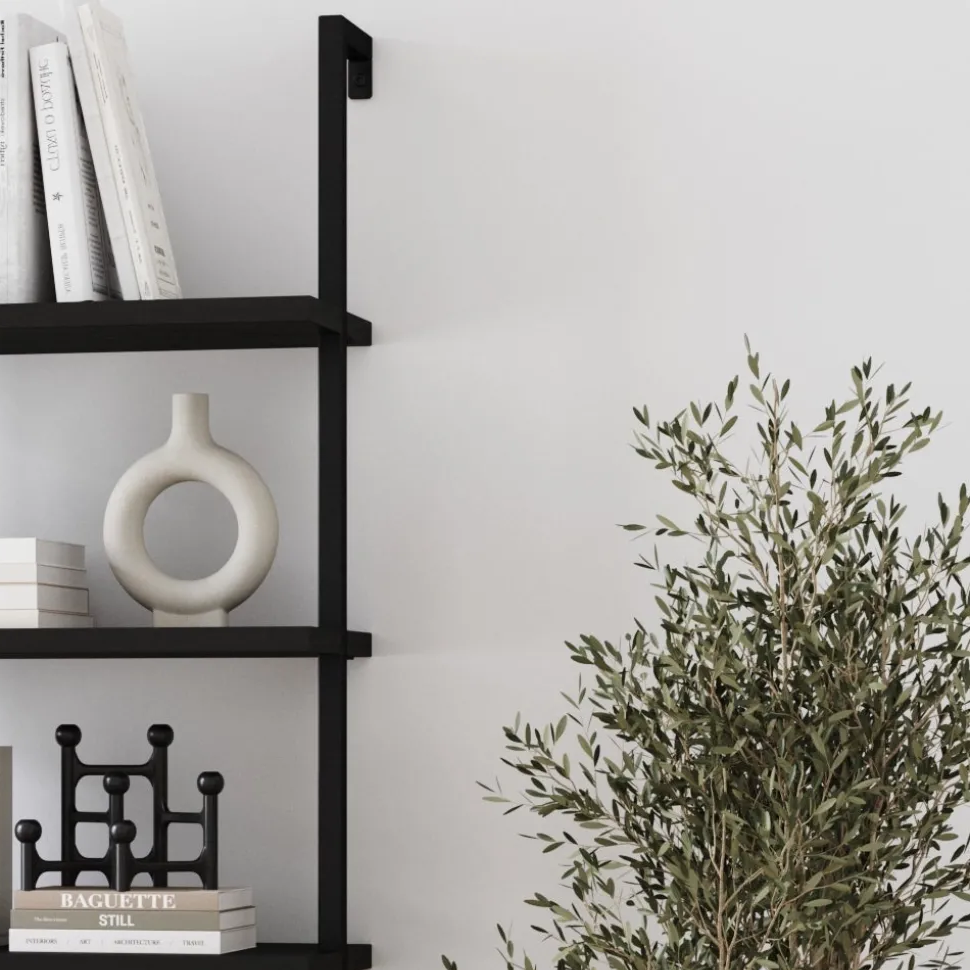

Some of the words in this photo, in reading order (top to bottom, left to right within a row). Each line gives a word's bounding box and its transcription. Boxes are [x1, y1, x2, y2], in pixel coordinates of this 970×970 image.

[60, 892, 176, 909] BAGUETTE
[99, 914, 135, 927] STILL
[182, 939, 205, 947] TRAVEL
